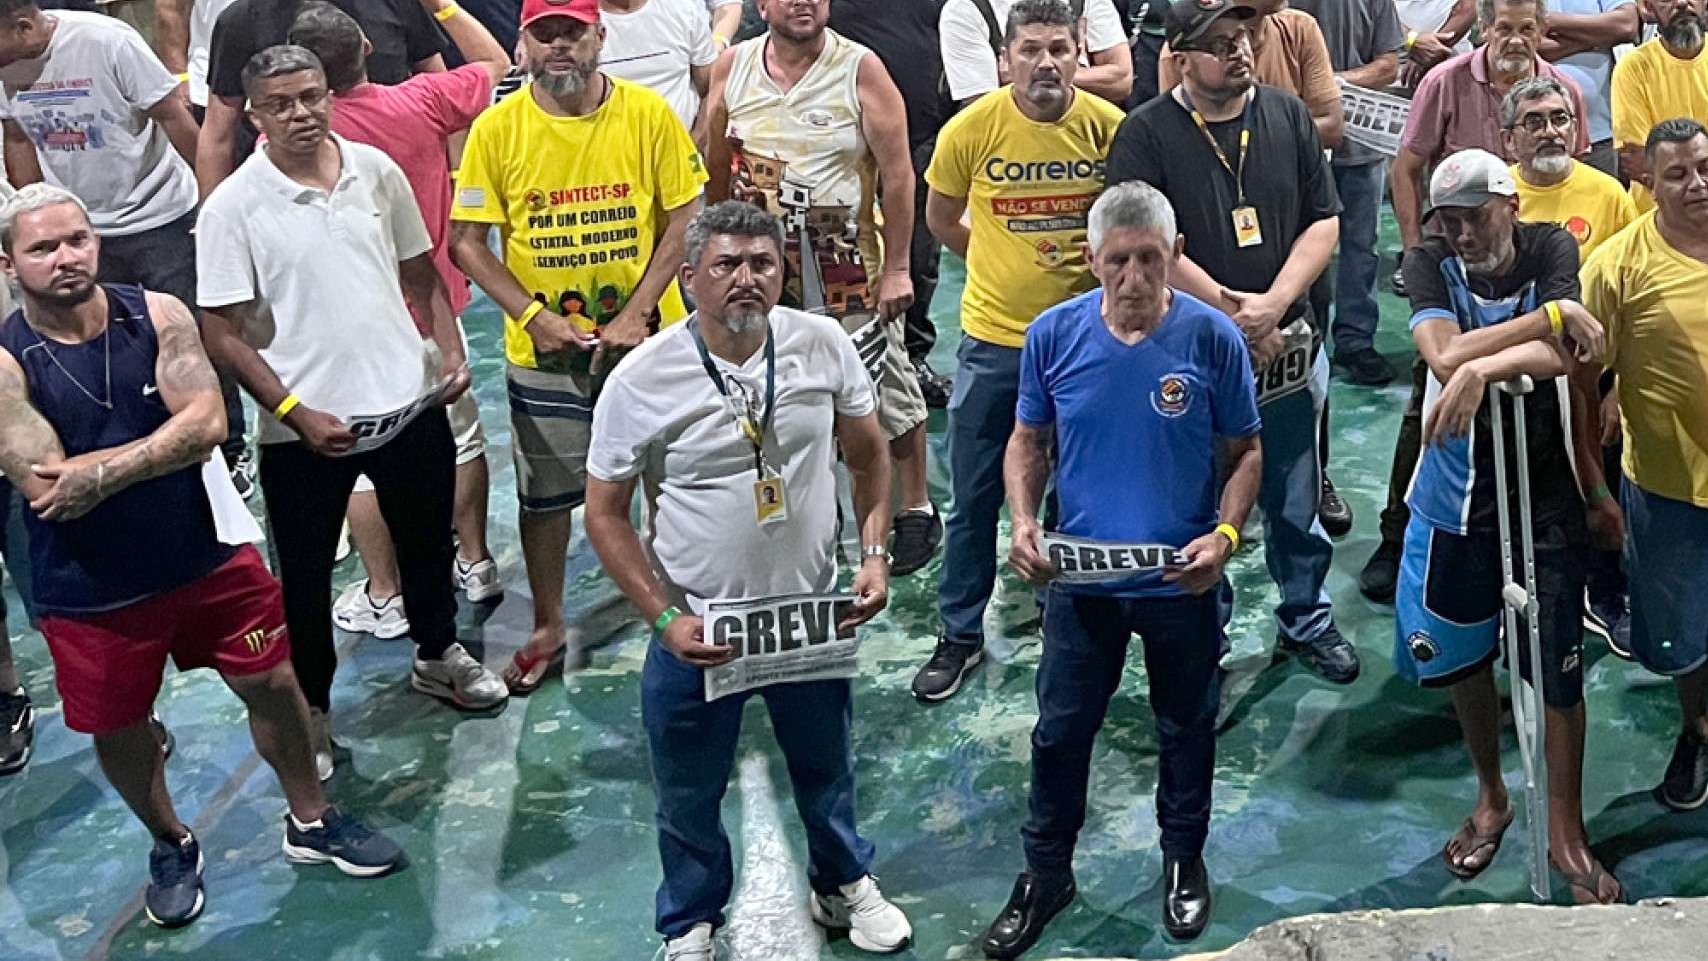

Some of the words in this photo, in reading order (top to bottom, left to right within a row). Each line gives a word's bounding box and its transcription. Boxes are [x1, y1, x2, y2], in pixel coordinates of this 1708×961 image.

[986, 157, 1106, 182] Correios
[549, 182, 631, 205] SINTECT-SP
[528, 214, 553, 229] POR
[556, 211, 577, 227] UM
[580, 205, 637, 225] CORREIO
[996, 199, 1028, 214] NÃO
[1031, 200, 1048, 213] SE
[580, 226, 638, 245] MODERNO
[590, 250, 607, 265] DO
[609, 245, 638, 262] POVO
[1048, 543, 1188, 572] GREVE
[713, 599, 857, 658] GREVE
